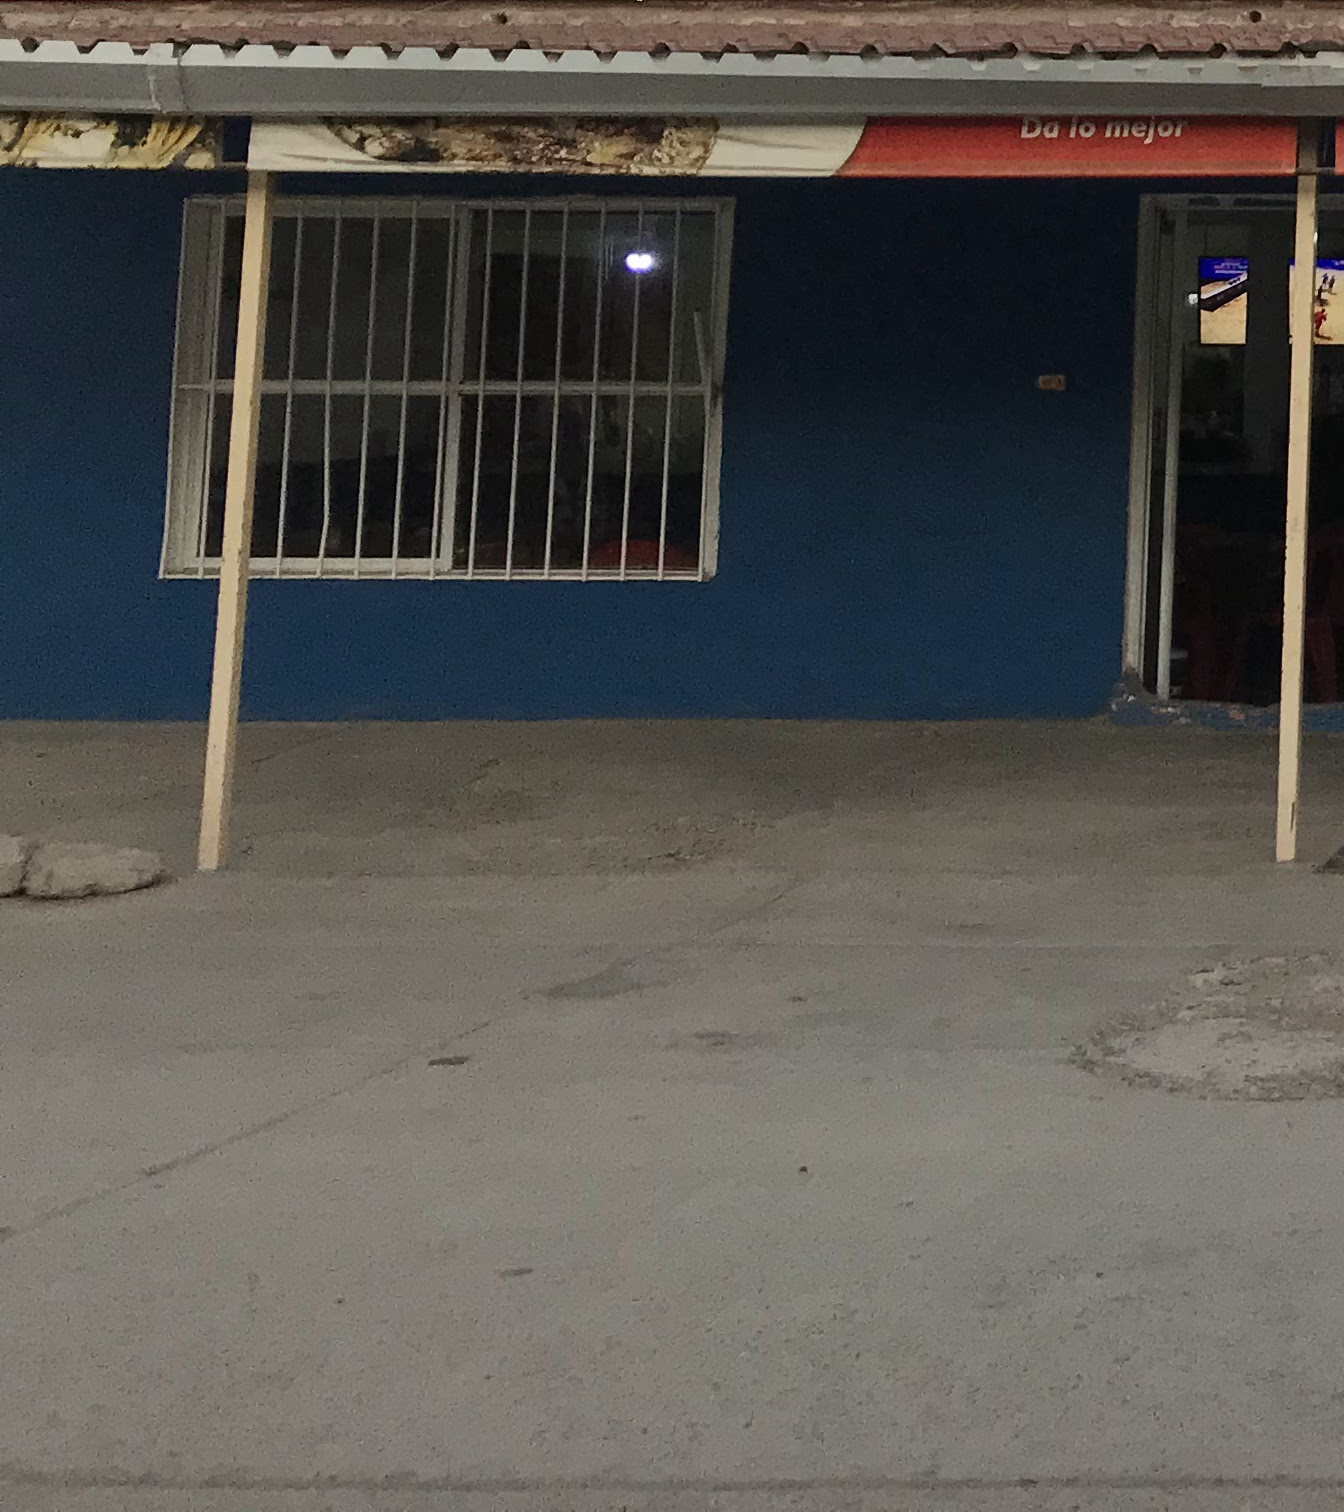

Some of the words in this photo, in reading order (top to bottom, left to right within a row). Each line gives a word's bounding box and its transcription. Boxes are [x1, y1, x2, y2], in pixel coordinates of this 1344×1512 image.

[1020, 116, 1059, 139] Da
[1069, 116, 1096, 138] lo
[1104, 116, 1188, 145] mejor
